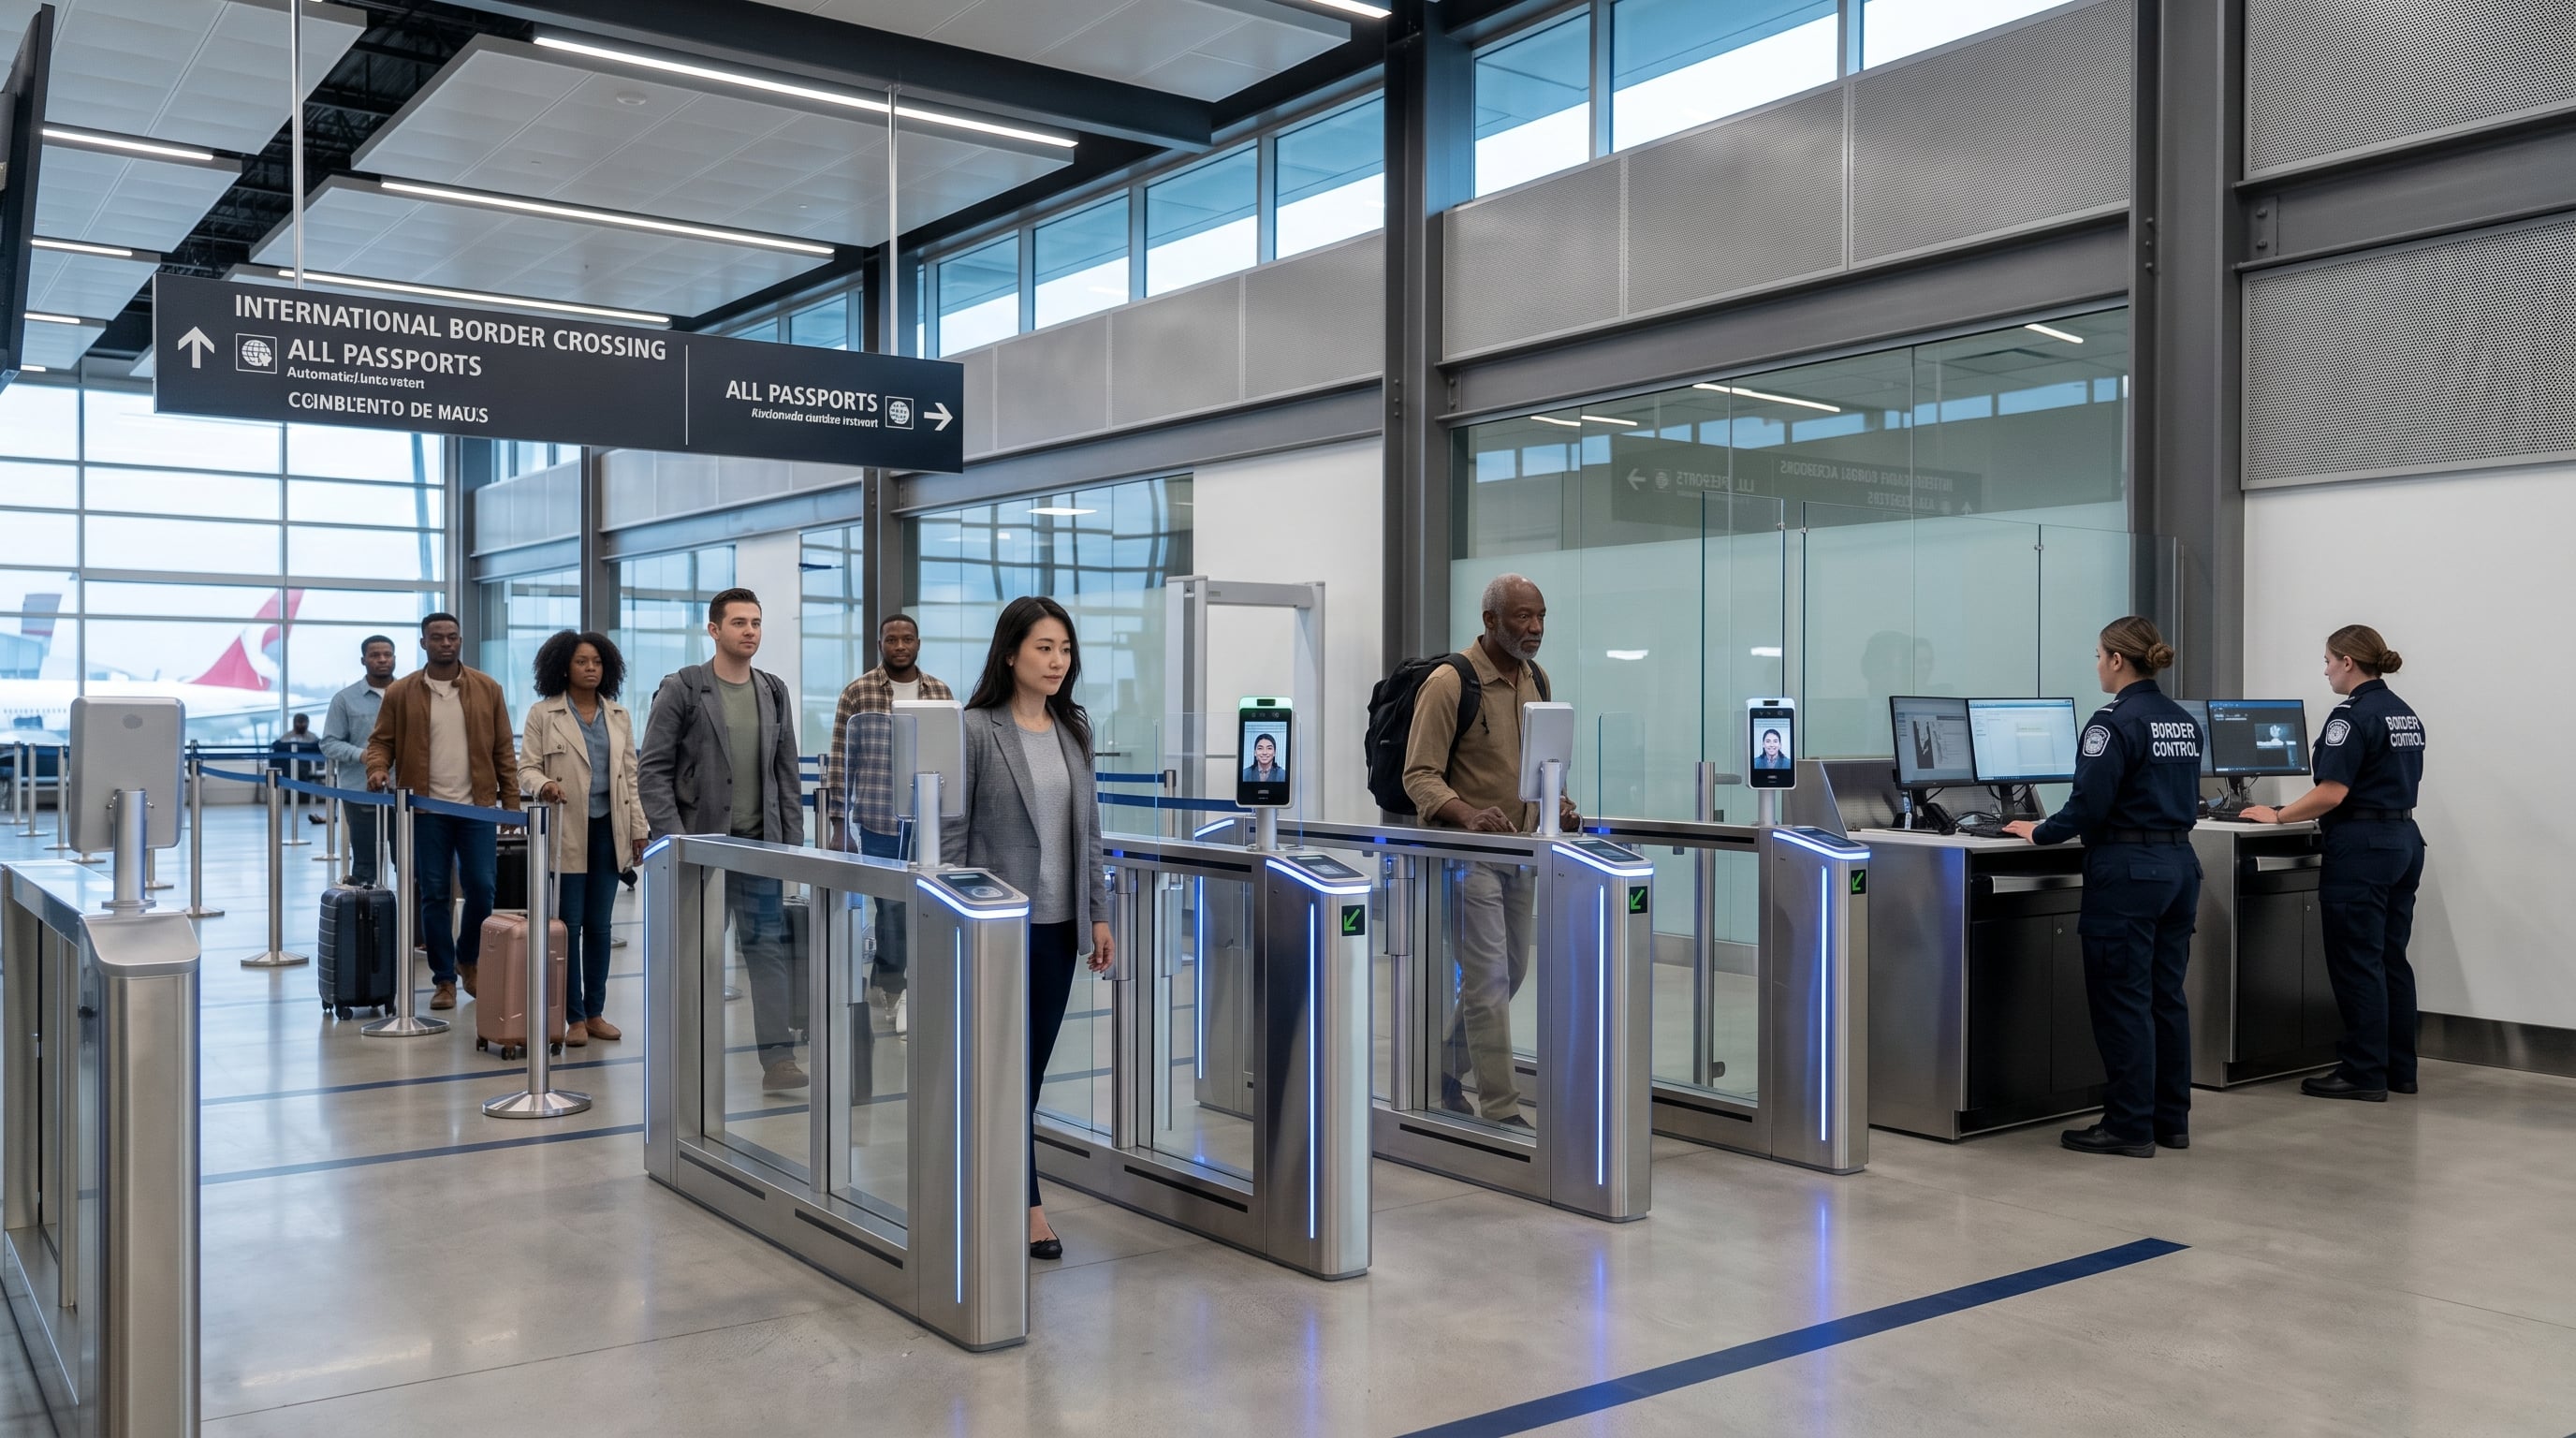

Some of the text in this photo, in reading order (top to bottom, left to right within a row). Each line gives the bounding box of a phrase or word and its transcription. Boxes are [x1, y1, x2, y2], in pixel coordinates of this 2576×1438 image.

[235, 294, 666, 360] INTERNATIONAL BORDER CROSSING
[287, 338, 482, 376] ALL PASSPORTS
[725, 379, 878, 413] ALL PASSPORTS
[410, 402, 433, 419] DE
[2150, 722, 2196, 739] BORDER
[2152, 741, 2200, 757] CONTROL
